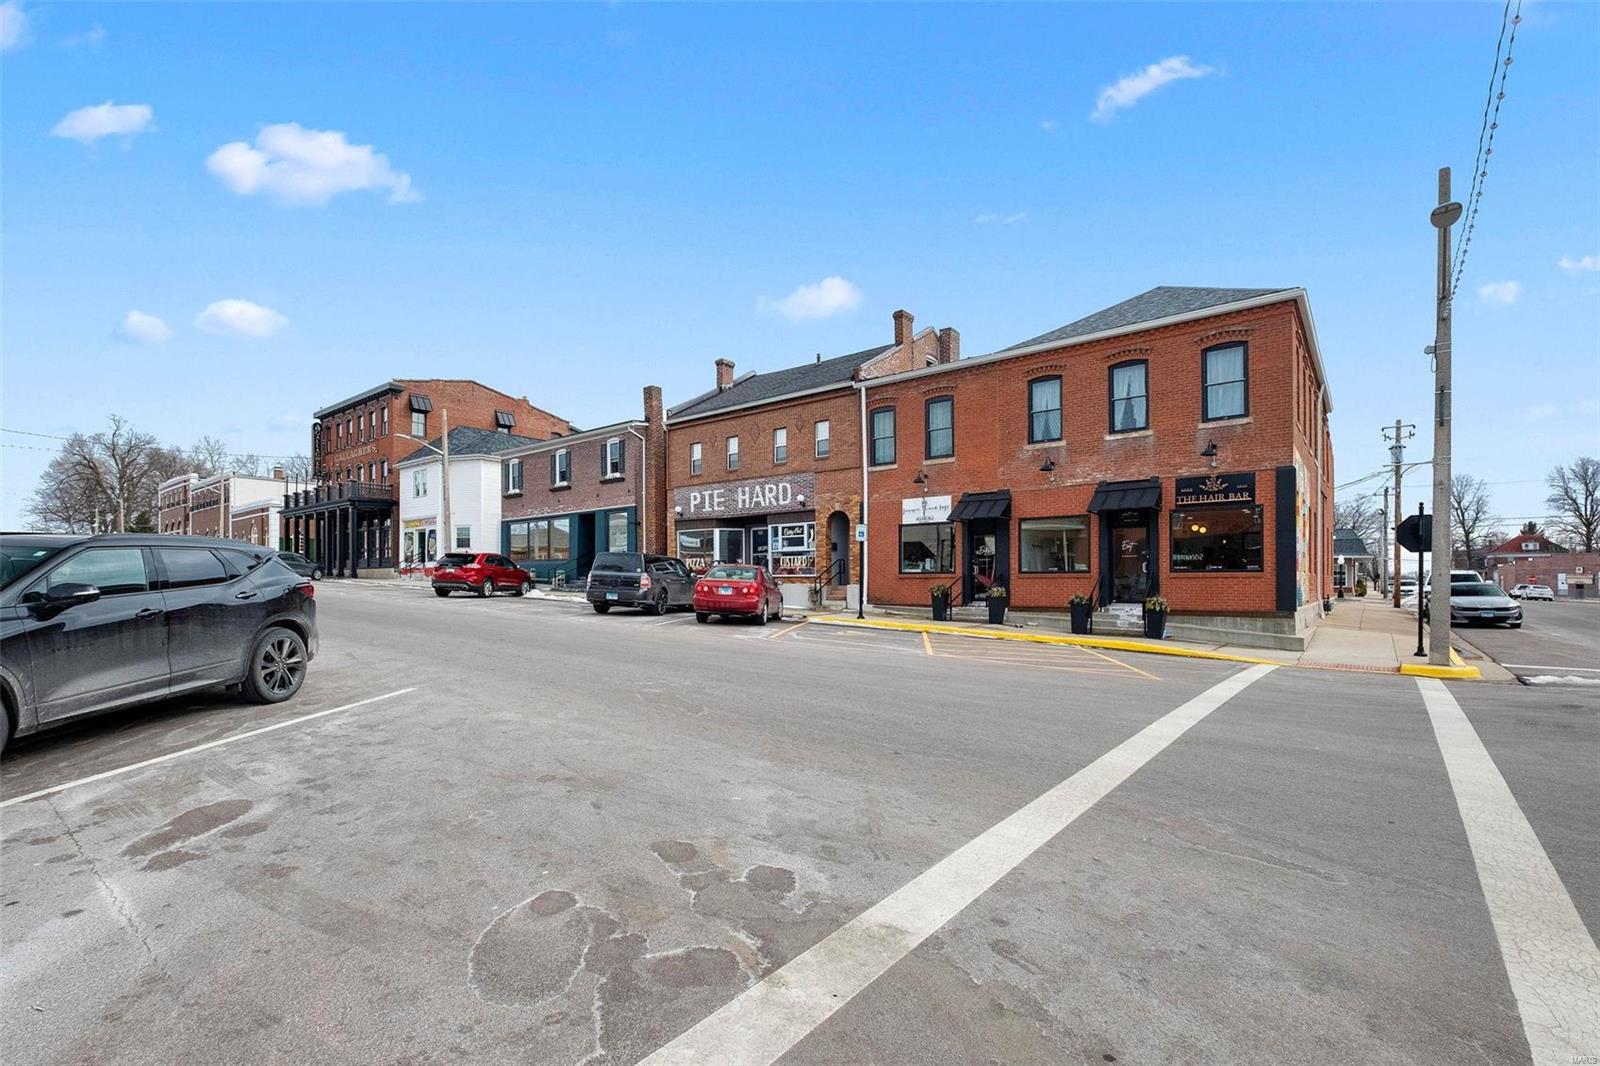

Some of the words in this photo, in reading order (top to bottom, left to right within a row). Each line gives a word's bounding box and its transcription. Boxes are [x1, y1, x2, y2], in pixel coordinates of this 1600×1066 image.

[690, 490, 725, 512] PIE
[737, 483, 791, 509] HARD
[1177, 495, 1197, 503] THE
[1199, 493, 1225, 503] HAIR
[1229, 491, 1249, 501] BAR
[686, 557, 705, 570] PIZZA
[780, 556, 807, 569] CUSTARD
